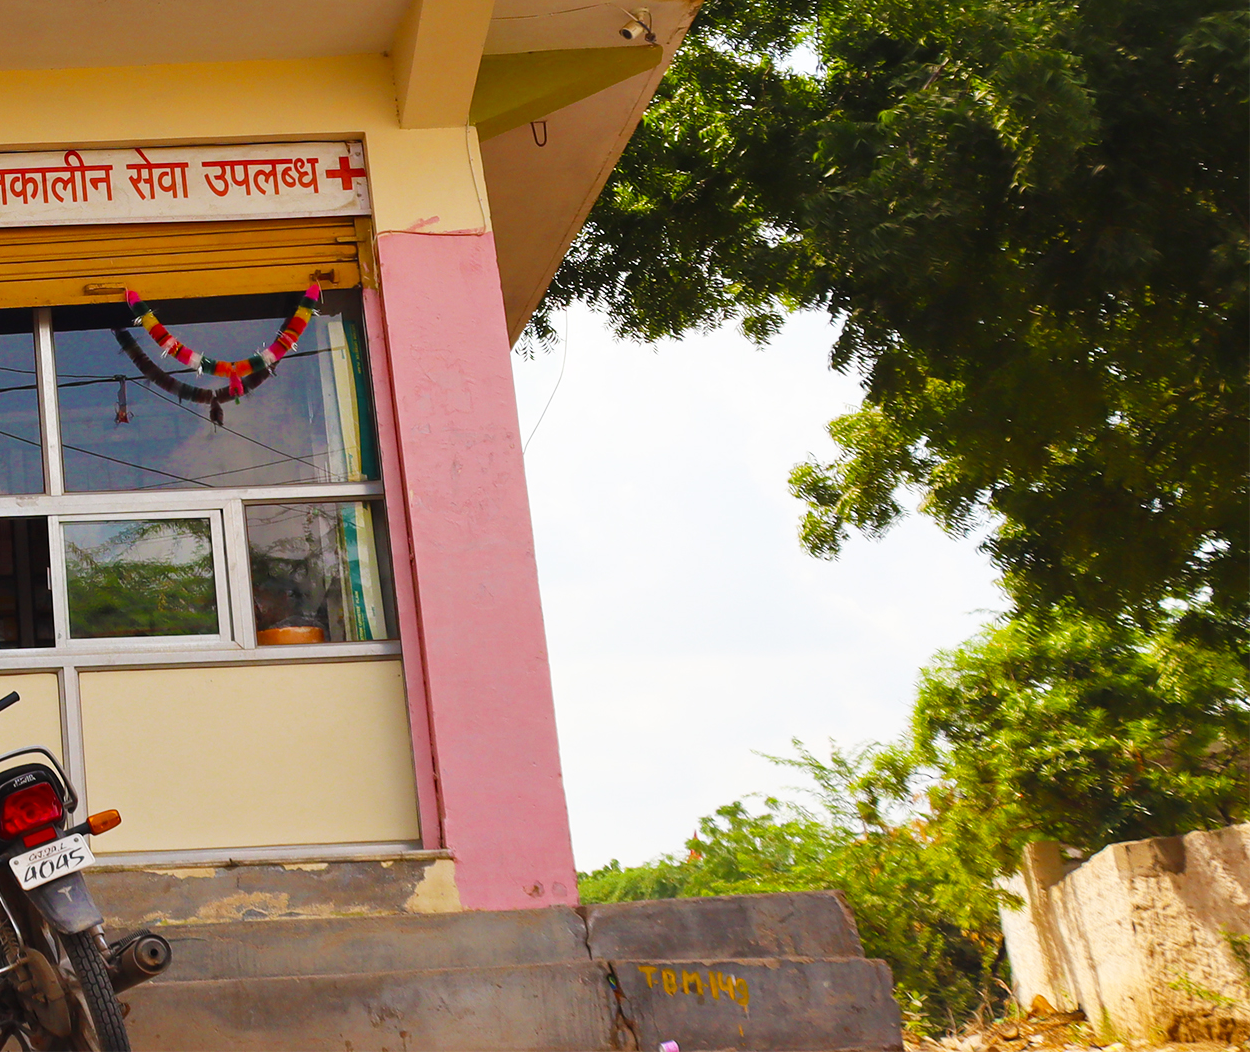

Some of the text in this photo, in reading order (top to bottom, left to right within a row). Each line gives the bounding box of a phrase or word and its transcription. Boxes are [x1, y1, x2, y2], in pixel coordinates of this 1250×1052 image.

[127, 149, 189, 200] सेवा
[202, 158, 319, 196] उपलब्ध
[24, 847, 85, 883] 4045
